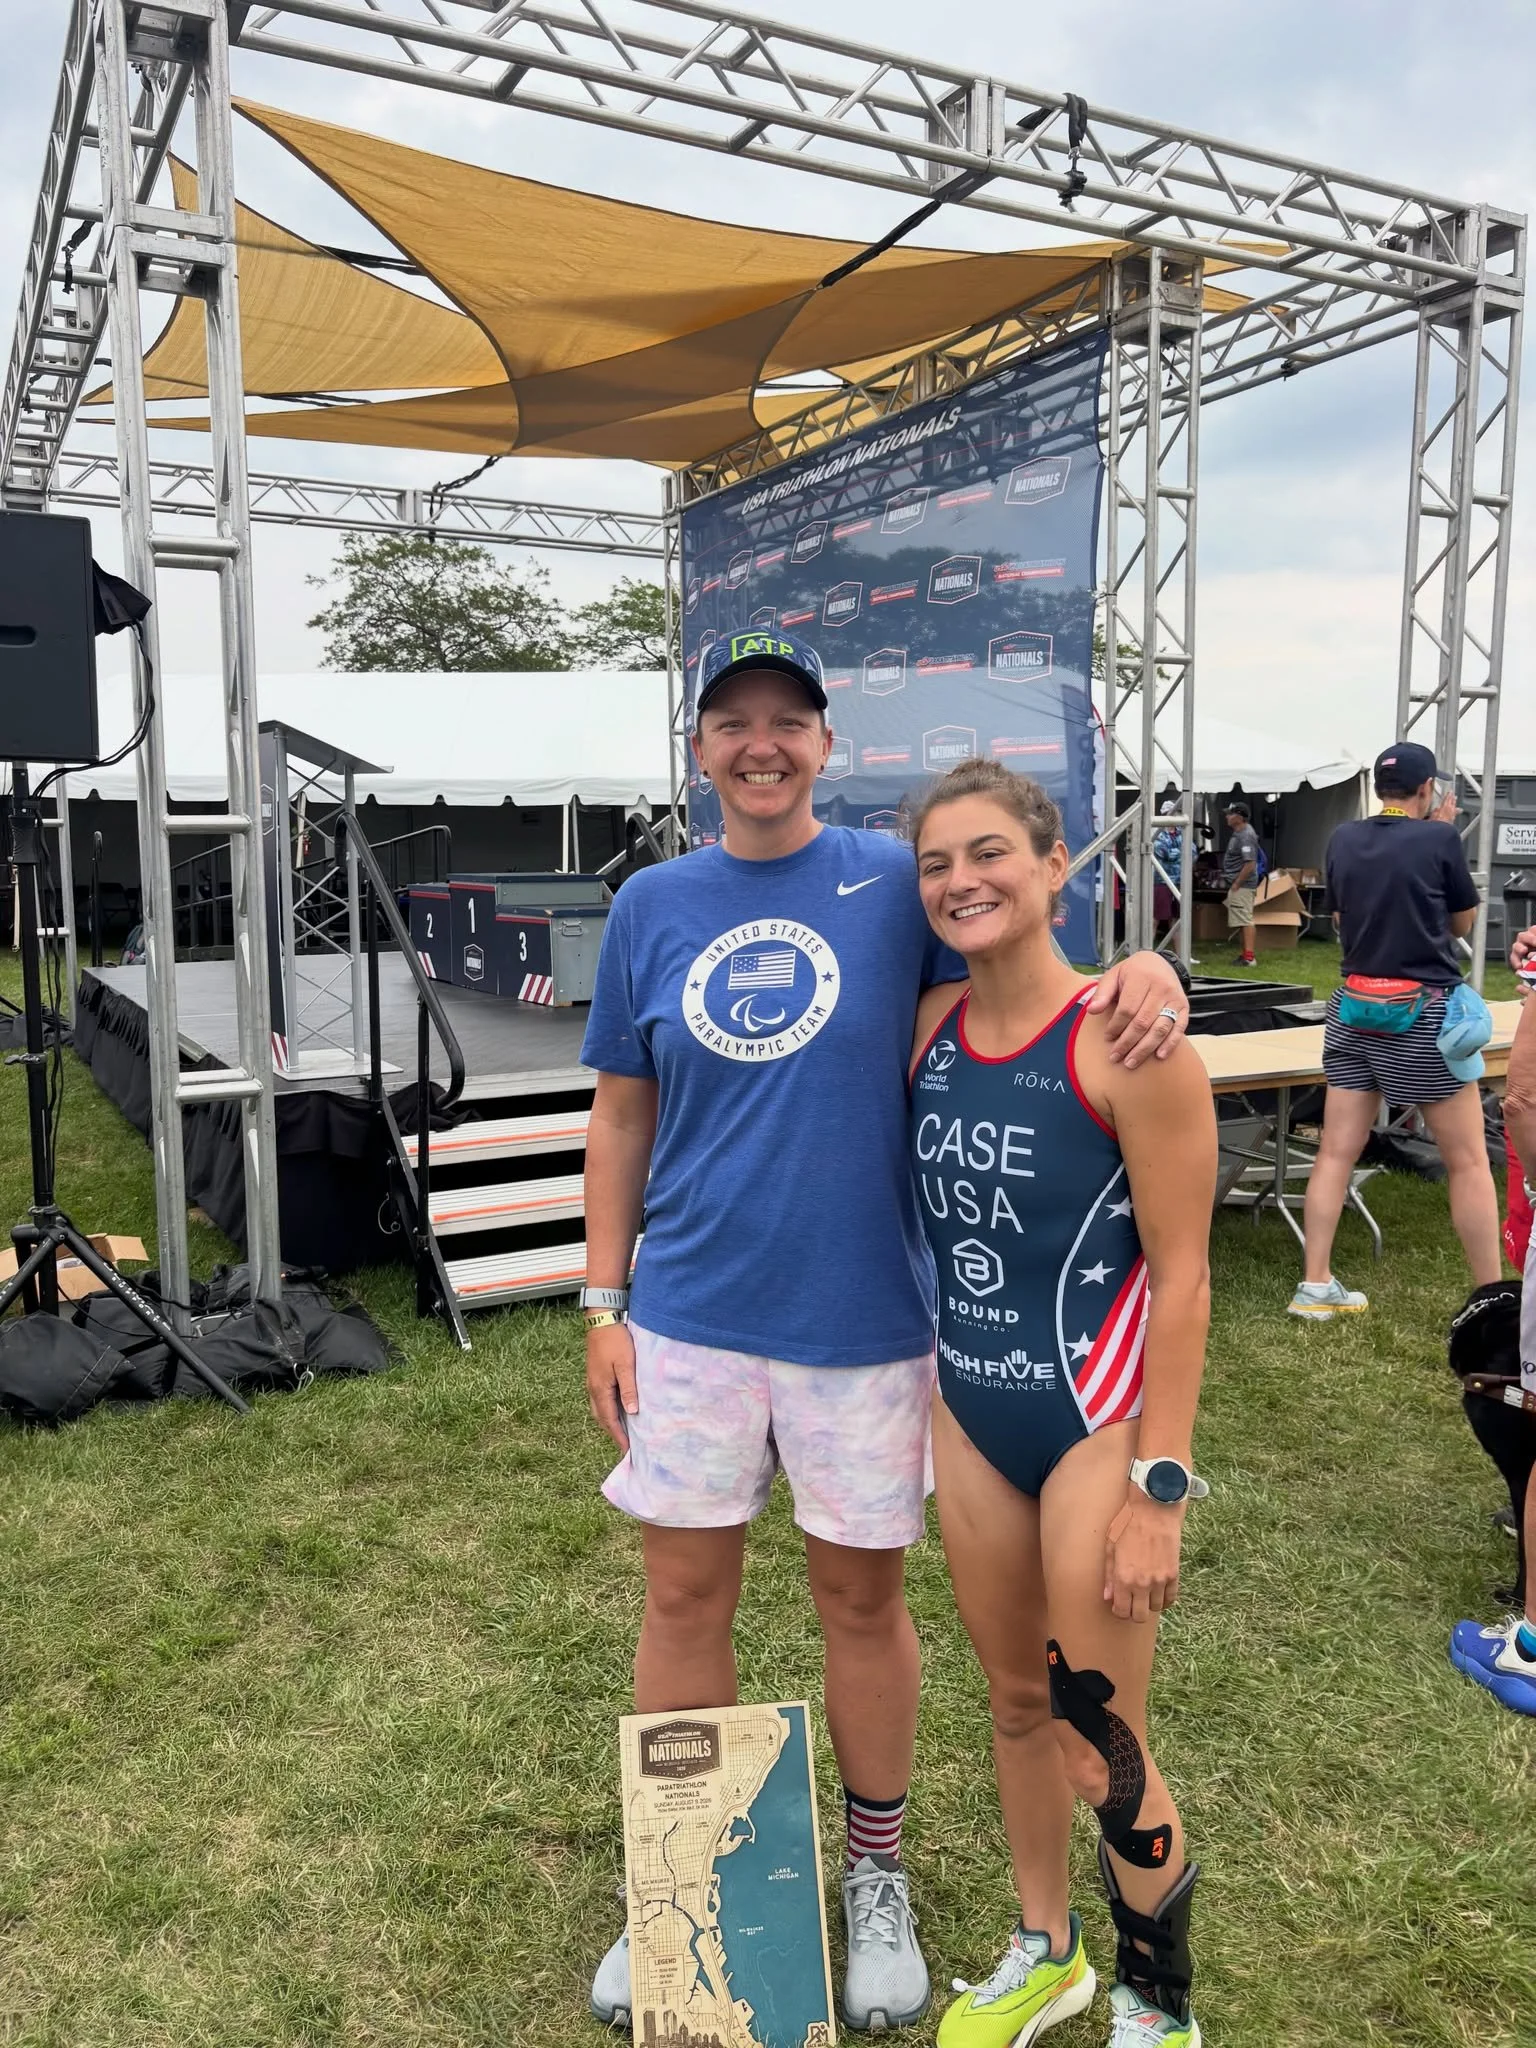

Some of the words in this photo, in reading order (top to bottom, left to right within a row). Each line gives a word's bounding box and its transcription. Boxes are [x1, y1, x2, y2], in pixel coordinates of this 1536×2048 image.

[741, 492, 767, 515] USA
[770, 454, 851, 502] TRIATHLON
[849, 406, 962, 468] NATIONALS
[1014, 473, 1061, 493] NATIONALS
[888, 503, 921, 523] NATIONALS
[935, 573, 973, 592] NATIONALS
[827, 597, 856, 615] NATIONALS
[743, 637, 794, 655] ATP
[996, 651, 1044, 669] NATIONALS
[868, 665, 900, 682] NATIONALS
[929, 744, 969, 760] NATIONALS
[426, 913, 434, 938] 2
[468, 897, 476, 934] 1
[518, 931, 527, 962] 3
[706, 925, 760, 962] UNITED
[769, 923, 823, 955] STATES
[691, 1013, 784, 1056] PARALYMPIC
[791, 1005, 826, 1042] TEAM
[919, 1081, 949, 1092] Triathlon
[924, 1073, 947, 1083] World
[917, 1113, 1035, 1178] CASE
[921, 1173, 1025, 1234] USA
[948, 1296, 1020, 1323] BOUND
[939, 1337, 981, 1374] HIGH
[984, 1349, 1056, 1379] FIVE
[955, 1369, 1057, 1391] ENDURANCE
[648, 1739, 712, 1763] NATIONALS
[656, 1781, 707, 1791] PARATRIATHLON
[664, 1790, 700, 1800] NATIONALS
[1152, 1837, 1164, 1859] KT
[767, 1872, 799, 1880] MICHIGAN
[774, 1866, 791, 1874] LAKE
[654, 1957, 677, 1966] LEGEND
